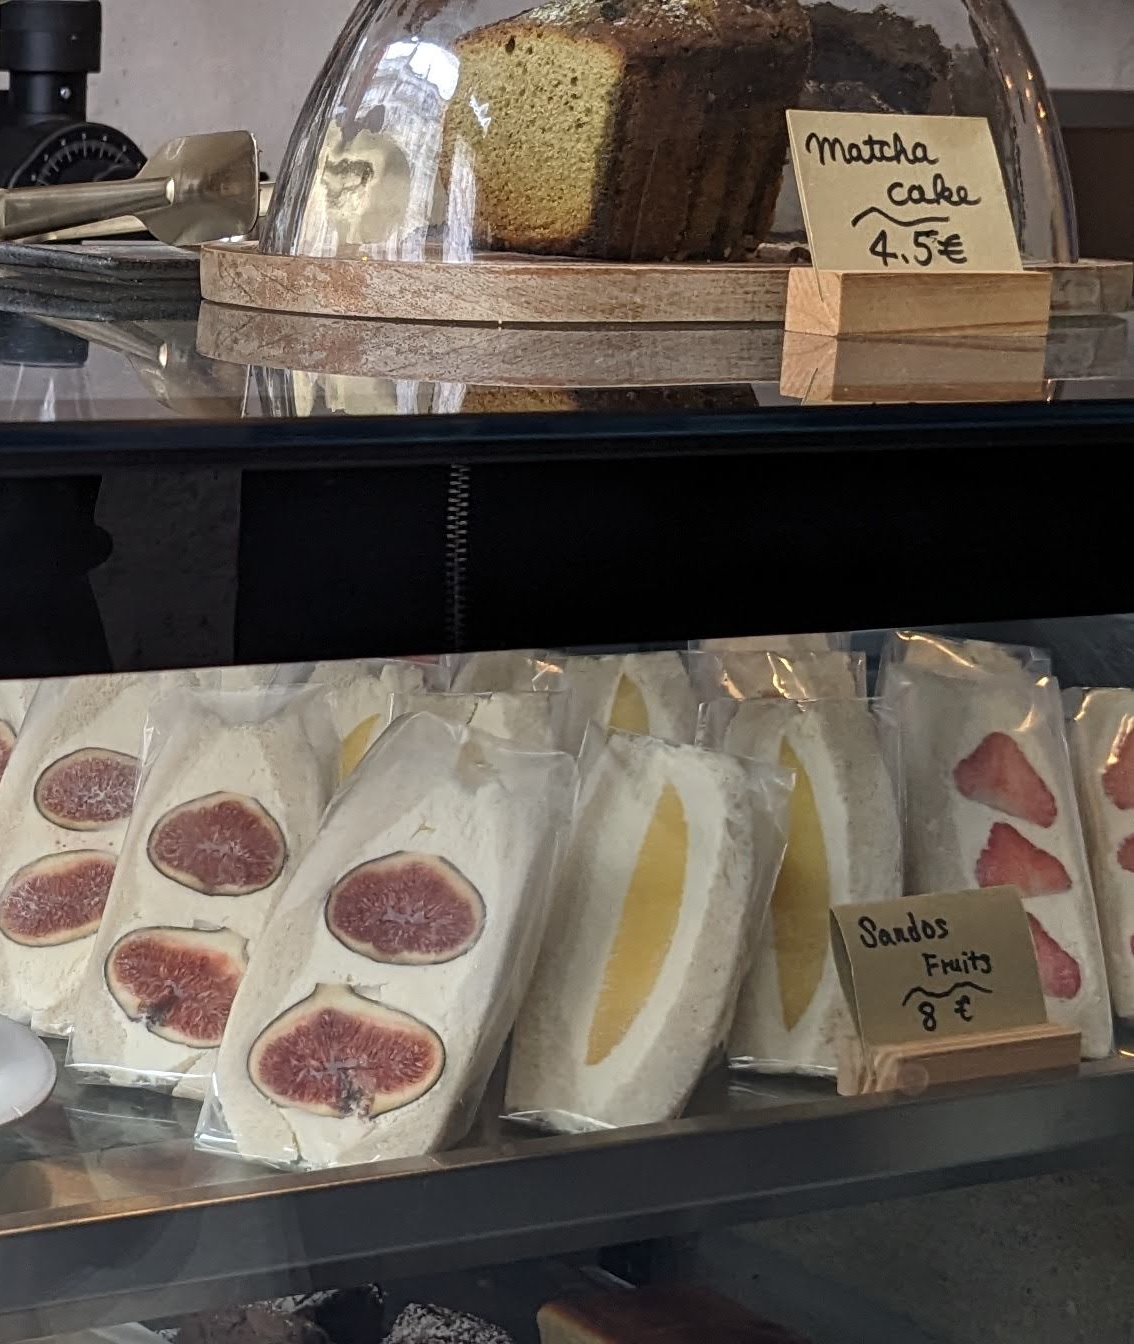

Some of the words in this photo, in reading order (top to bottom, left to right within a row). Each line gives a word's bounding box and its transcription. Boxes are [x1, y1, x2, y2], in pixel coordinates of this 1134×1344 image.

[887, 172, 982, 207] cake
[858, 911, 950, 949] Sandos
[922, 950, 993, 978] Fruits
